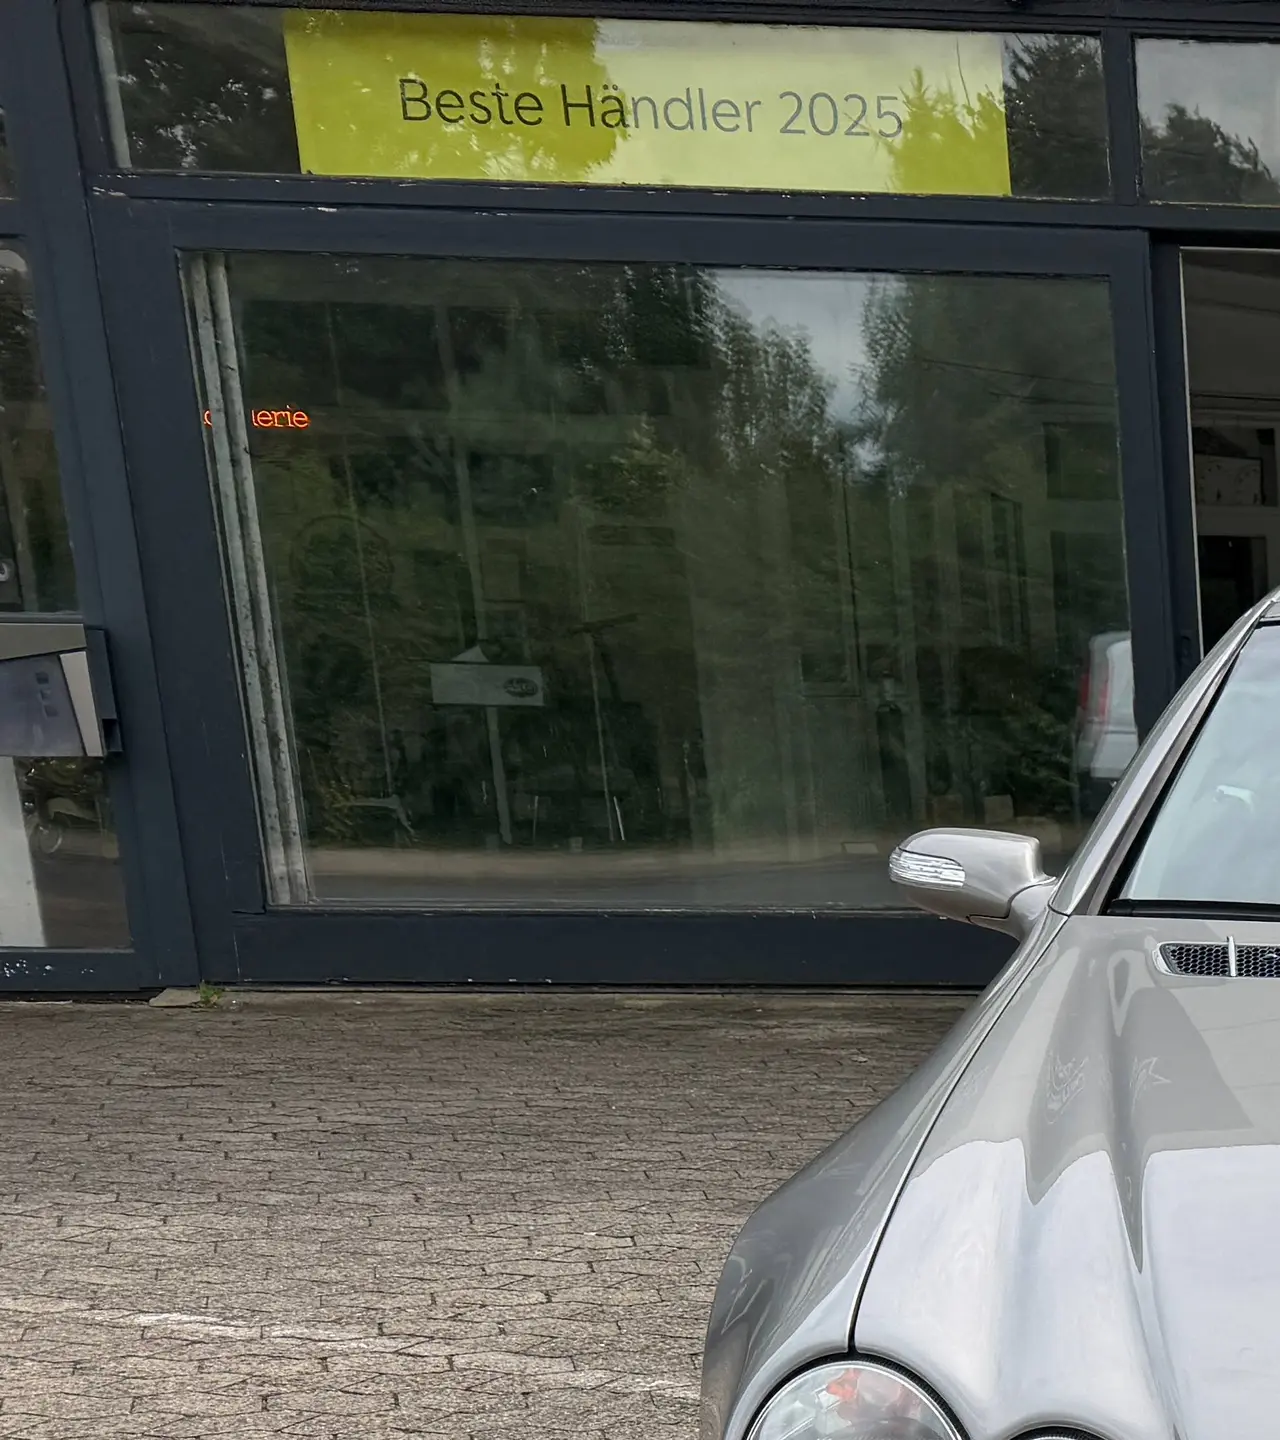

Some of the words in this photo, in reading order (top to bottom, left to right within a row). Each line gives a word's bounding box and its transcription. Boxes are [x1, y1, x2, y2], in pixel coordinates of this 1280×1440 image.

[400, 78, 543, 127] Beste
[561, 83, 762, 133] Händler
[778, 92, 904, 138] 2025
